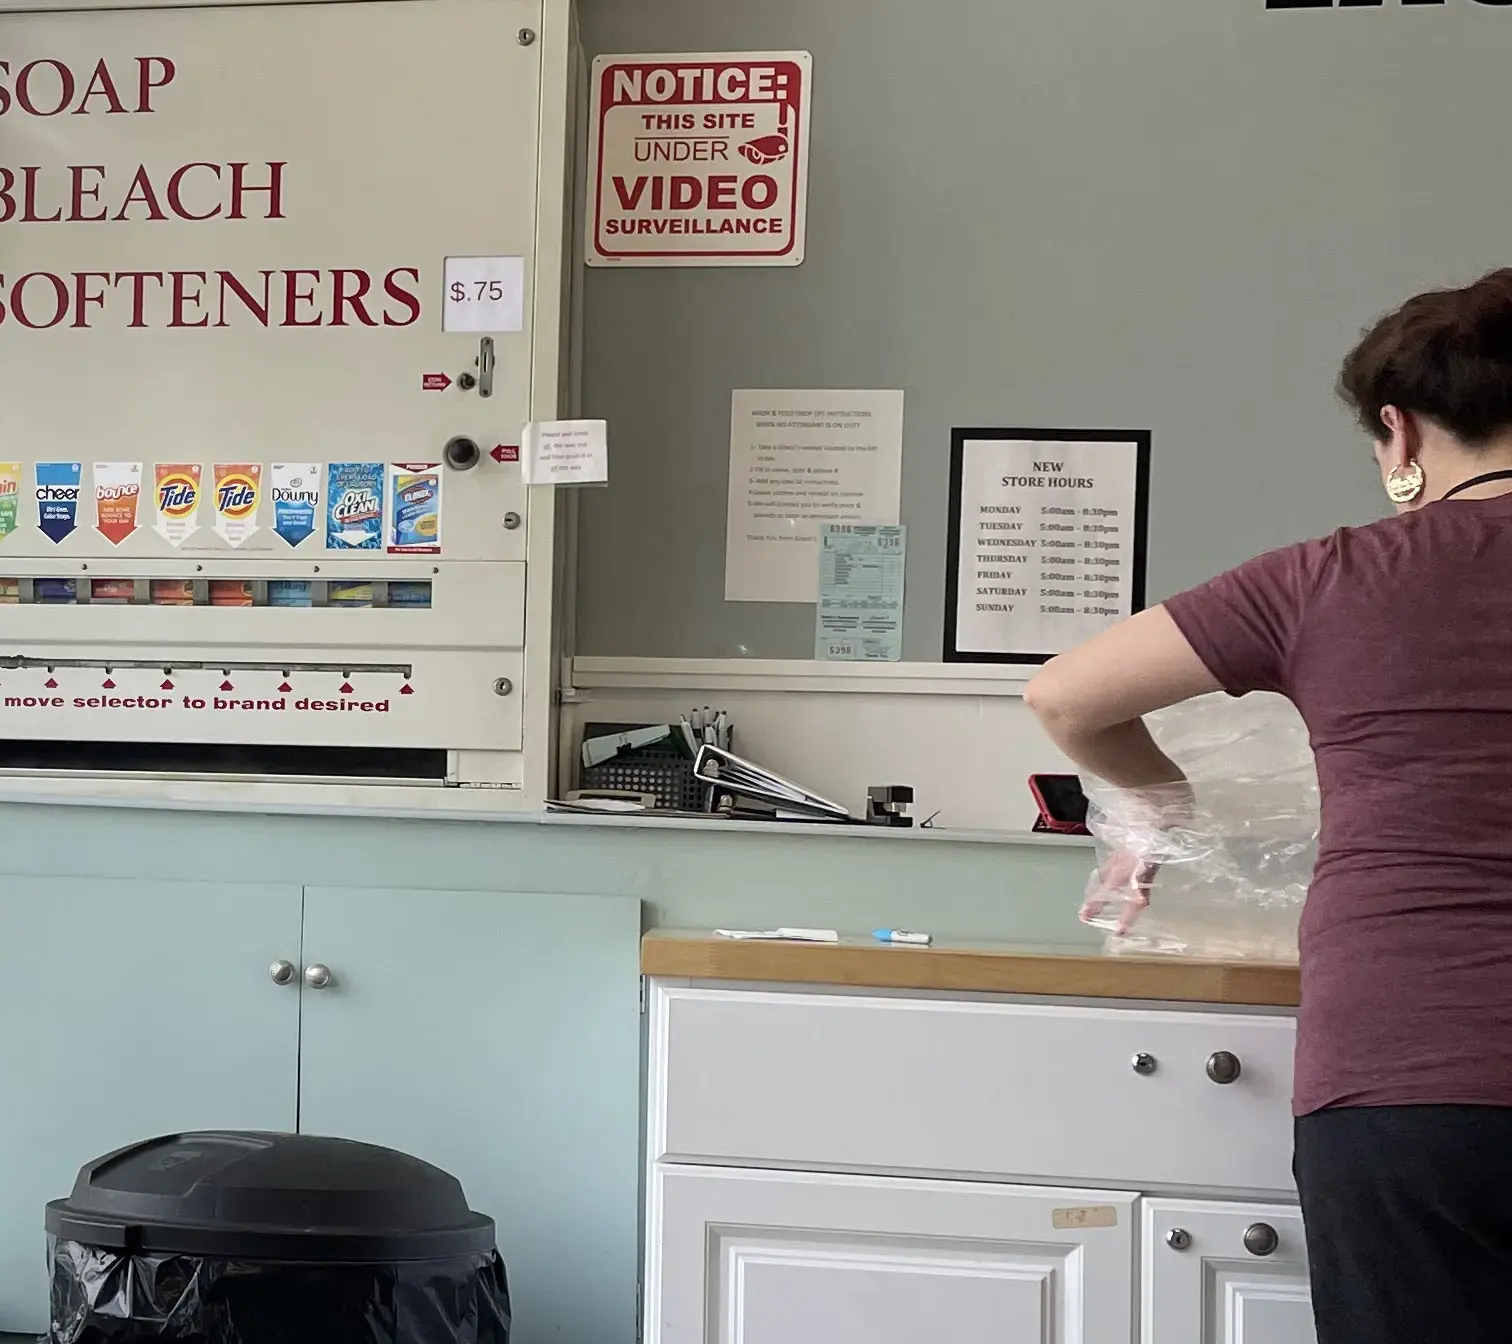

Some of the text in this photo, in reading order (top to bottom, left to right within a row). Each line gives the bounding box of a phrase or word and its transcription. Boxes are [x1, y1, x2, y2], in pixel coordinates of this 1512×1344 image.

[612, 67, 788, 103] NOTICE:
[640, 112, 756, 130] THIS SITE
[633, 140, 729, 162] UNDER
[611, 174, 779, 211] VIDEO
[605, 218, 784, 235] SURVEILLANCE
[450, 279, 504, 304] $.75
[1032, 461, 1064, 473] NEW
[1001, 476, 1094, 489] STORE HOURS
[36, 485, 80, 501] cheer
[95, 483, 139, 501] bounce
[159, 484, 196, 512] Tide
[218, 484, 255, 512] Tide
[271, 487, 319, 506] Downy
[343, 490, 368, 505] OXI
[334, 498, 376, 520] CLEAN
[980, 506, 1022, 514] MONDAY
[977, 539, 1037, 547] WEDNESDAY
[977, 555, 1028, 563] THURSDAY
[978, 571, 1012, 579] FRIDAY
[976, 588, 1027, 596] SATURDAY
[4, 694, 390, 713] move selector to brand desired
